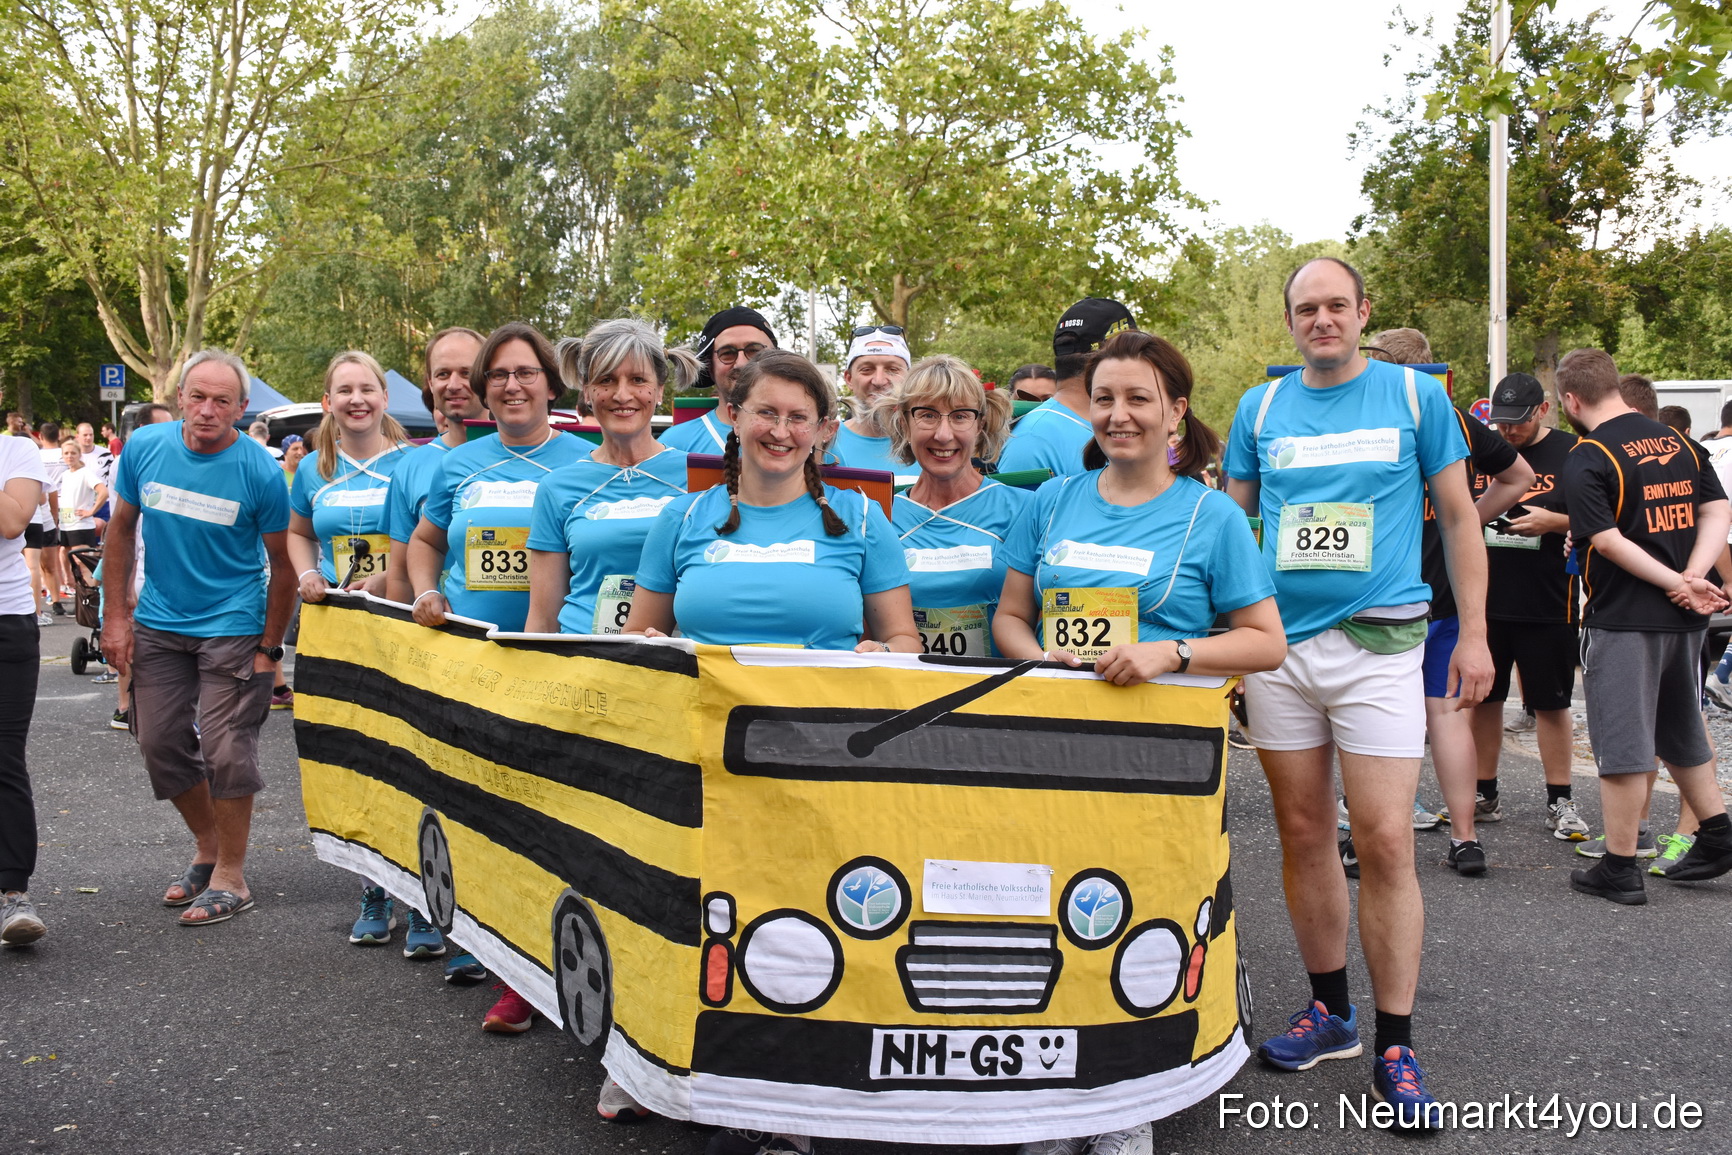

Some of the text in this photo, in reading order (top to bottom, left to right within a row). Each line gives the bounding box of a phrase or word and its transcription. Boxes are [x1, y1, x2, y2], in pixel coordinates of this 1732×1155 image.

[1065, 319, 1083, 327] ROSSI
[105, 367, 119, 385] P
[1320, 441, 1356, 450] katholische
[1621, 436, 1681, 458] BIT WINGS
[1474, 474, 1484, 489] BIT
[178, 496, 206, 507] katholische
[206, 503, 235, 513] Volksschule
[1645, 502, 1694, 533] LAUFEN
[1296, 527, 1349, 550] 829
[349, 553, 387, 573] 831
[481, 550, 528, 573] 833
[1117, 554, 1147, 562] Volksschule
[614, 601, 631, 627] 8
[1089, 607, 1131, 617] walk 2019
[964, 622, 982, 630] 2019
[1056, 618, 1111, 647] 832
[471, 664, 502, 692] DER
[932, 882, 1044, 893] Freie katholische Volksschule
[941, 892, 958, 900] Haus
[959, 892, 968, 900] St.
[968, 892, 994, 902] Marien,
[880, 1033, 1025, 1077] NM-GS
